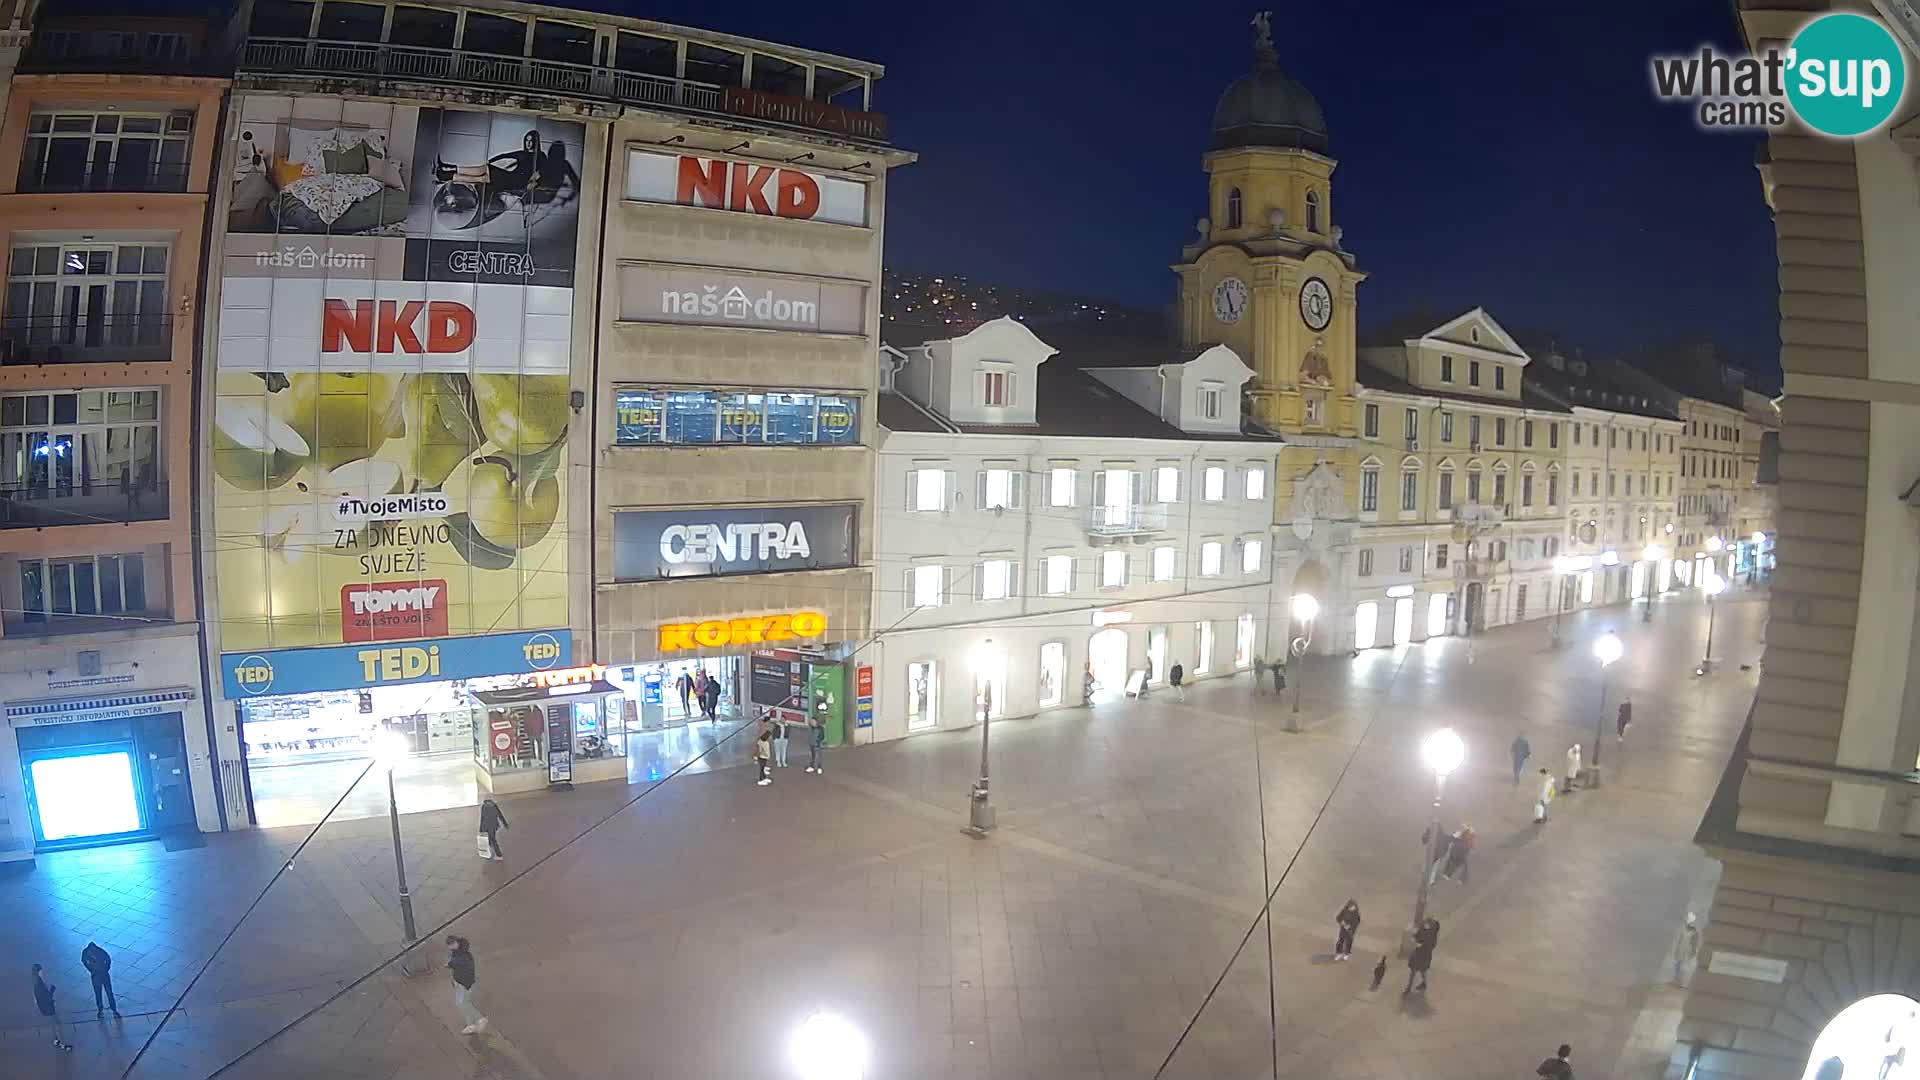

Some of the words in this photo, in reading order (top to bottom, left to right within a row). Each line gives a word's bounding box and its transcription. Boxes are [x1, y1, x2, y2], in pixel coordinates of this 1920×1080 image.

[675, 155, 821, 220] NKD
[255, 246, 295, 268] naš
[320, 247, 366, 269] dom
[449, 250, 536, 277] CENTRA
[662, 285, 719, 316] naš
[754, 290, 817, 323] dom
[321, 298, 478, 354] NKD
[339, 497, 447, 516] #TvojeMisto
[334, 529, 358, 549] ZA
[367, 524, 451, 548] DNEVNO
[660, 521, 811, 564] CENTRA
[360, 548, 427, 575] SVJEŽE
[350, 586, 440, 615] TOMMY
[658, 612, 827, 652] KORZO
[357, 645, 441, 682] TEDi
[523, 642, 561, 660] TEDi
[234, 666, 274, 684] TEDi
